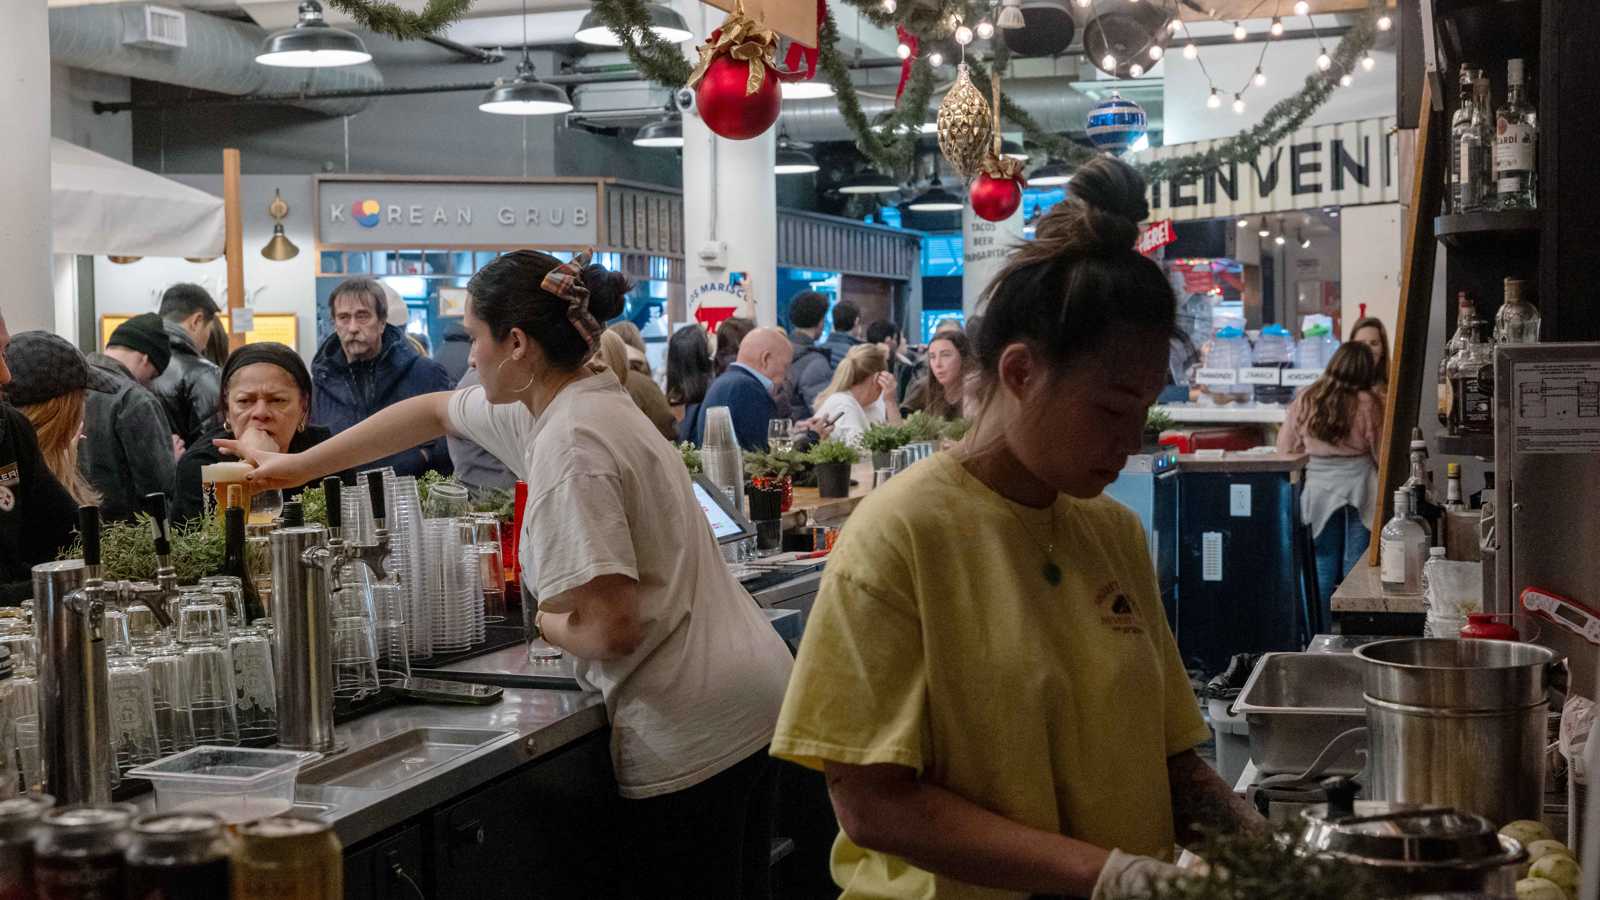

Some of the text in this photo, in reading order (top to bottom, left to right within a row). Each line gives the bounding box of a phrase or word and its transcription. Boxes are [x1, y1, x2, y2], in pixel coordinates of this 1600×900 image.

[498, 206, 589, 226] GRUB
[971, 223, 996, 232] TACOS
[973, 237, 994, 246] BEER
